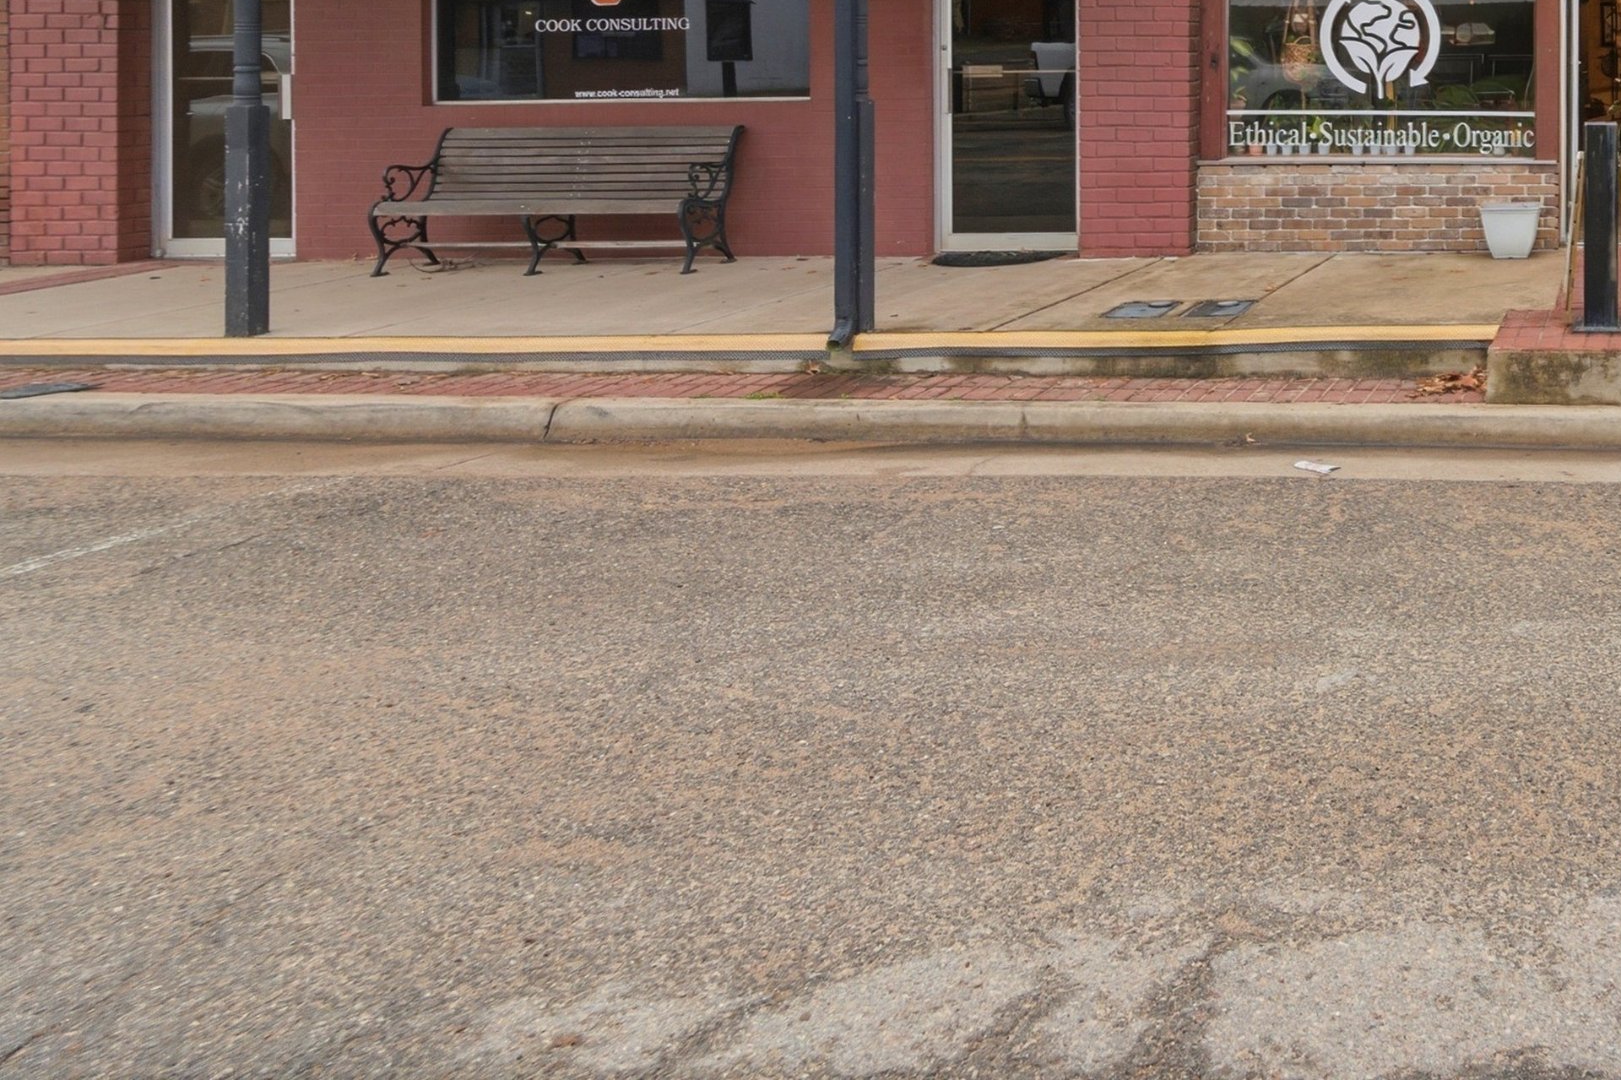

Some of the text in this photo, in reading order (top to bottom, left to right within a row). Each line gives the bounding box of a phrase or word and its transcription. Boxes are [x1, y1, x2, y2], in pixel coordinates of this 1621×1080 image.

[535, 17, 690, 32] COOK CONSULTING
[574, 88, 680, 99] www.cook-consulting.net
[1229, 121, 1535, 154] Ethical Sustainable Organic
